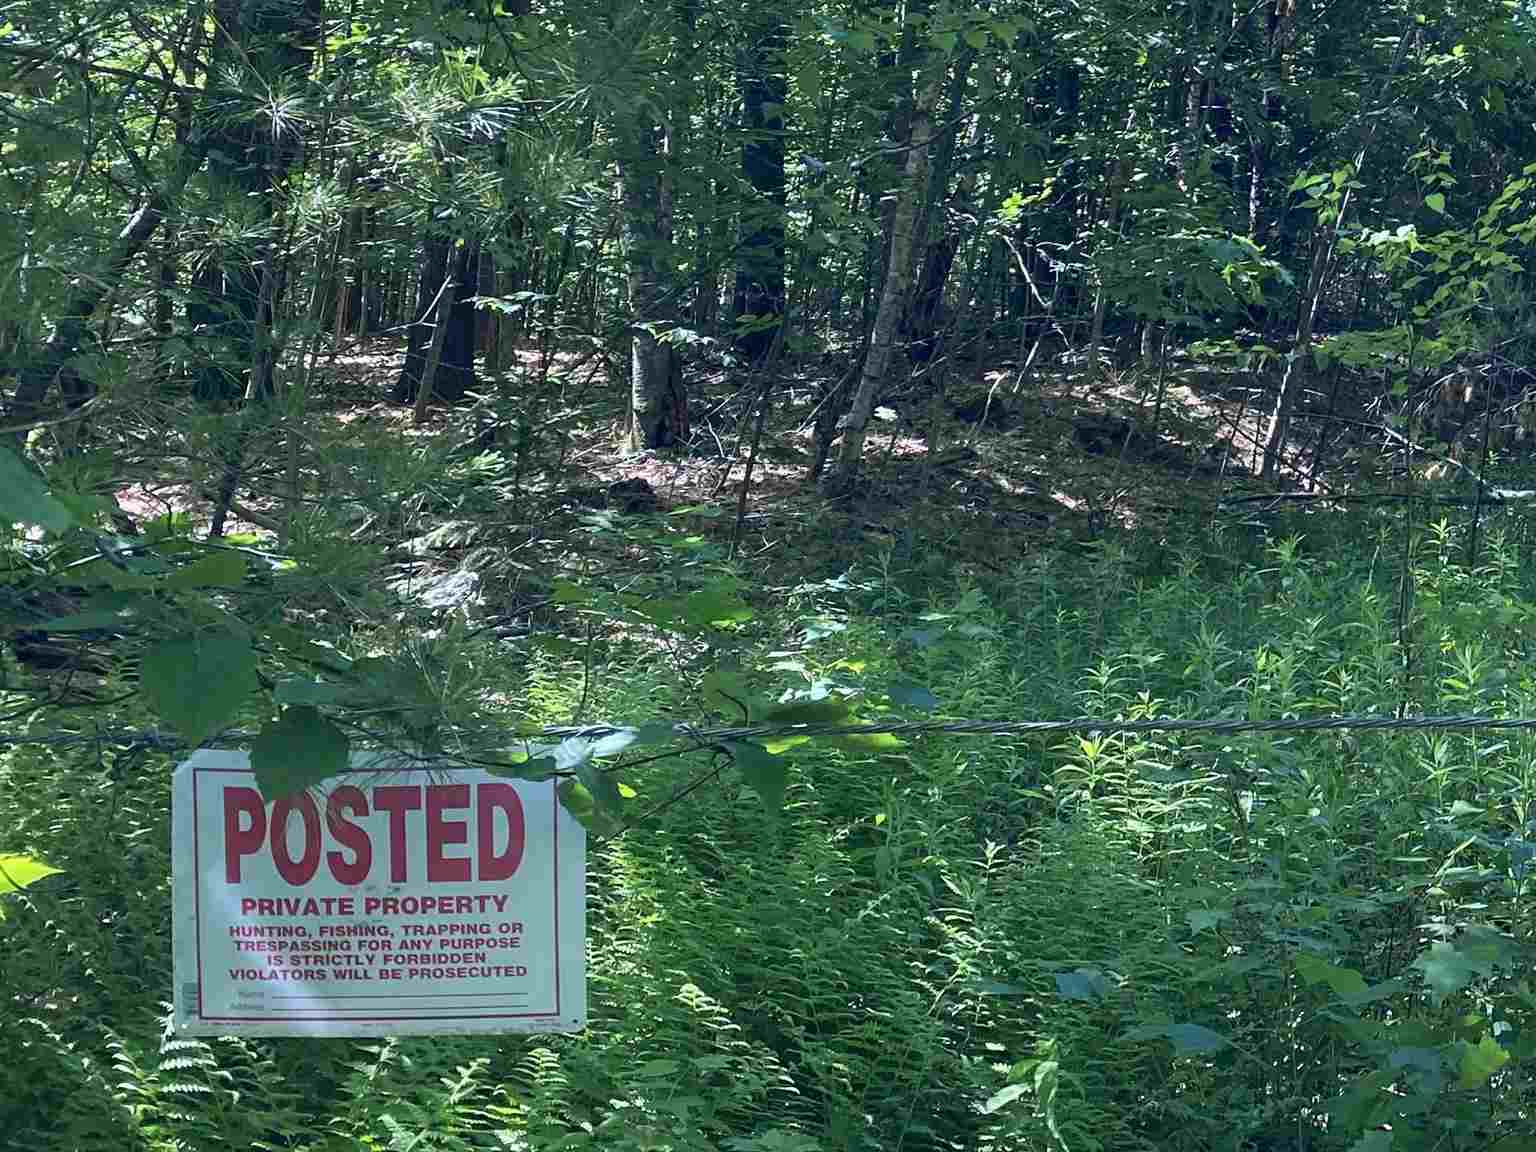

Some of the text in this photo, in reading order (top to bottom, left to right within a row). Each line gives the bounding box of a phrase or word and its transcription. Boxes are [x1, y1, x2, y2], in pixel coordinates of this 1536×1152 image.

[223, 784, 526, 887] POSTED
[241, 895, 509, 916] PRIVATE PROPERTY
[229, 922, 524, 939] HUNTING, FISHING, TRAPPING OR
[233, 936, 521, 952] TRESPASSING FOR ANY PURPOSE
[267, 952, 487, 967] IS STRICTLY FORBIDDEN
[229, 965, 528, 981] VIOLATORS WILL BE PROSECUTED
